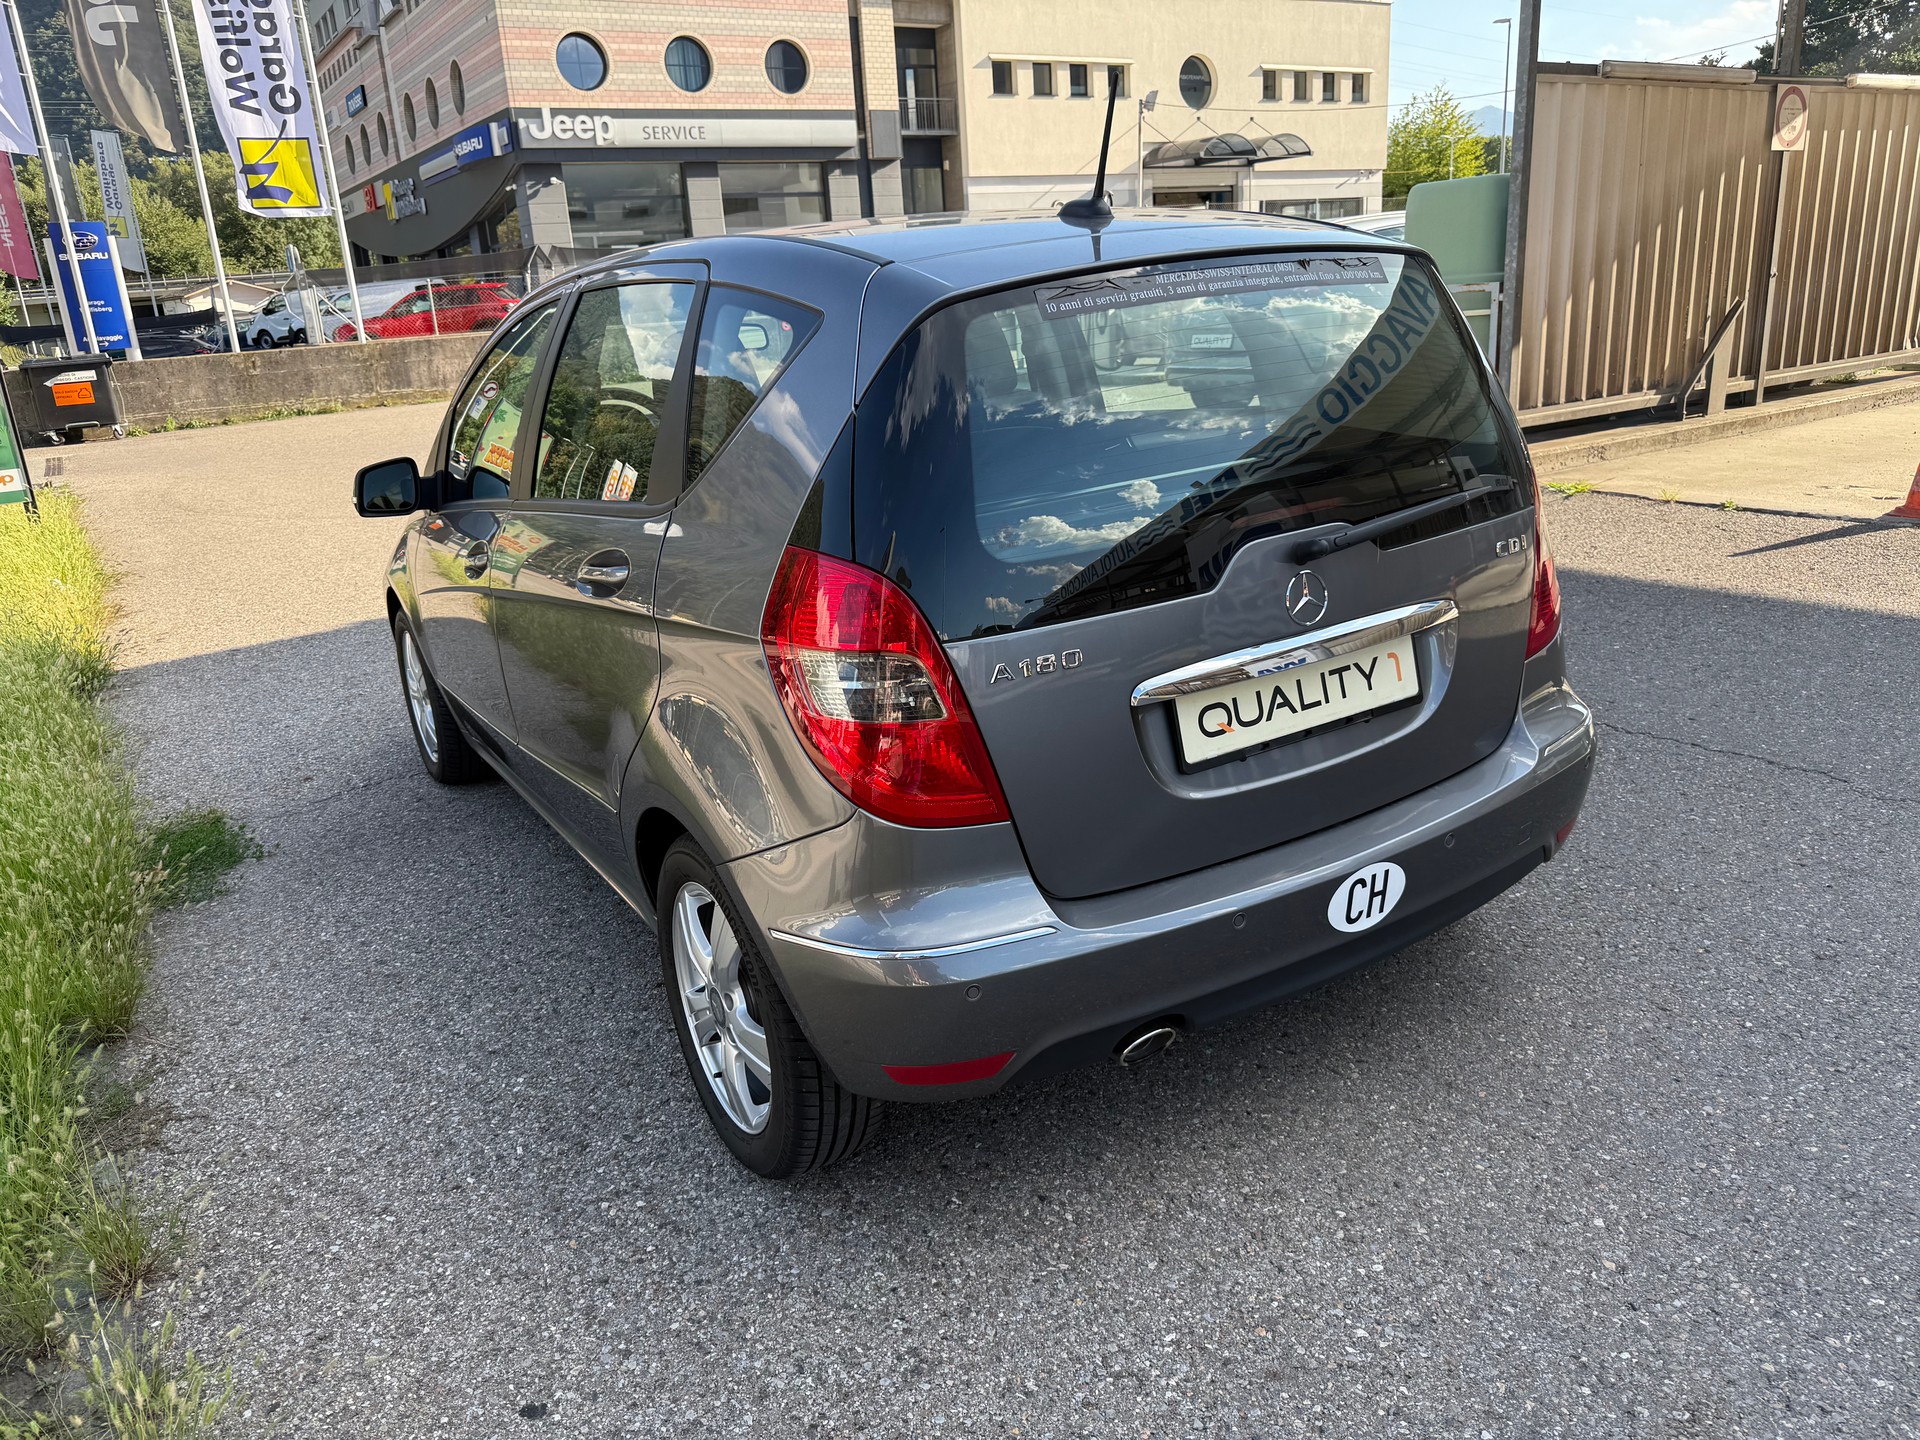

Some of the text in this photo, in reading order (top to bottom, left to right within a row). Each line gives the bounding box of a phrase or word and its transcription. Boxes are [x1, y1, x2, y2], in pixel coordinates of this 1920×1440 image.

[528, 107, 615, 145] Jeep
[642, 125, 706, 141] SERVICE
[456, 136, 483, 156] SUBARU
[58, 252, 109, 261] SBARU
[1155, 262, 1295, 285] MERCEDES-SWISS-INTEGRAL (MSI)
[1045, 303, 1057, 314] 10
[1059, 300, 1082, 311] anni
[1084, 297, 1094, 307] di
[1096, 292, 1128, 305] servizi
[1129, 287, 1167, 302] gratuiti,
[1168, 285, 1174, 295] 3
[1175, 283, 1196, 294] anni
[1197, 281, 1207, 291] di
[1208, 278, 1244, 292] garanzia
[1244, 275, 1284, 286] integrale,
[1284, 272, 1318, 283] entrambi
[1319, 271, 1334, 280] fino
[1341, 270, 1369, 279] 100'000
[1369, 270, 1384, 279] km.
[1496, 534, 1527, 558] CDI
[1197, 652, 1404, 739] QUALITY 1
[1345, 868, 1391, 924] CH
[709, 878, 763, 999] BRIDGESTONE
